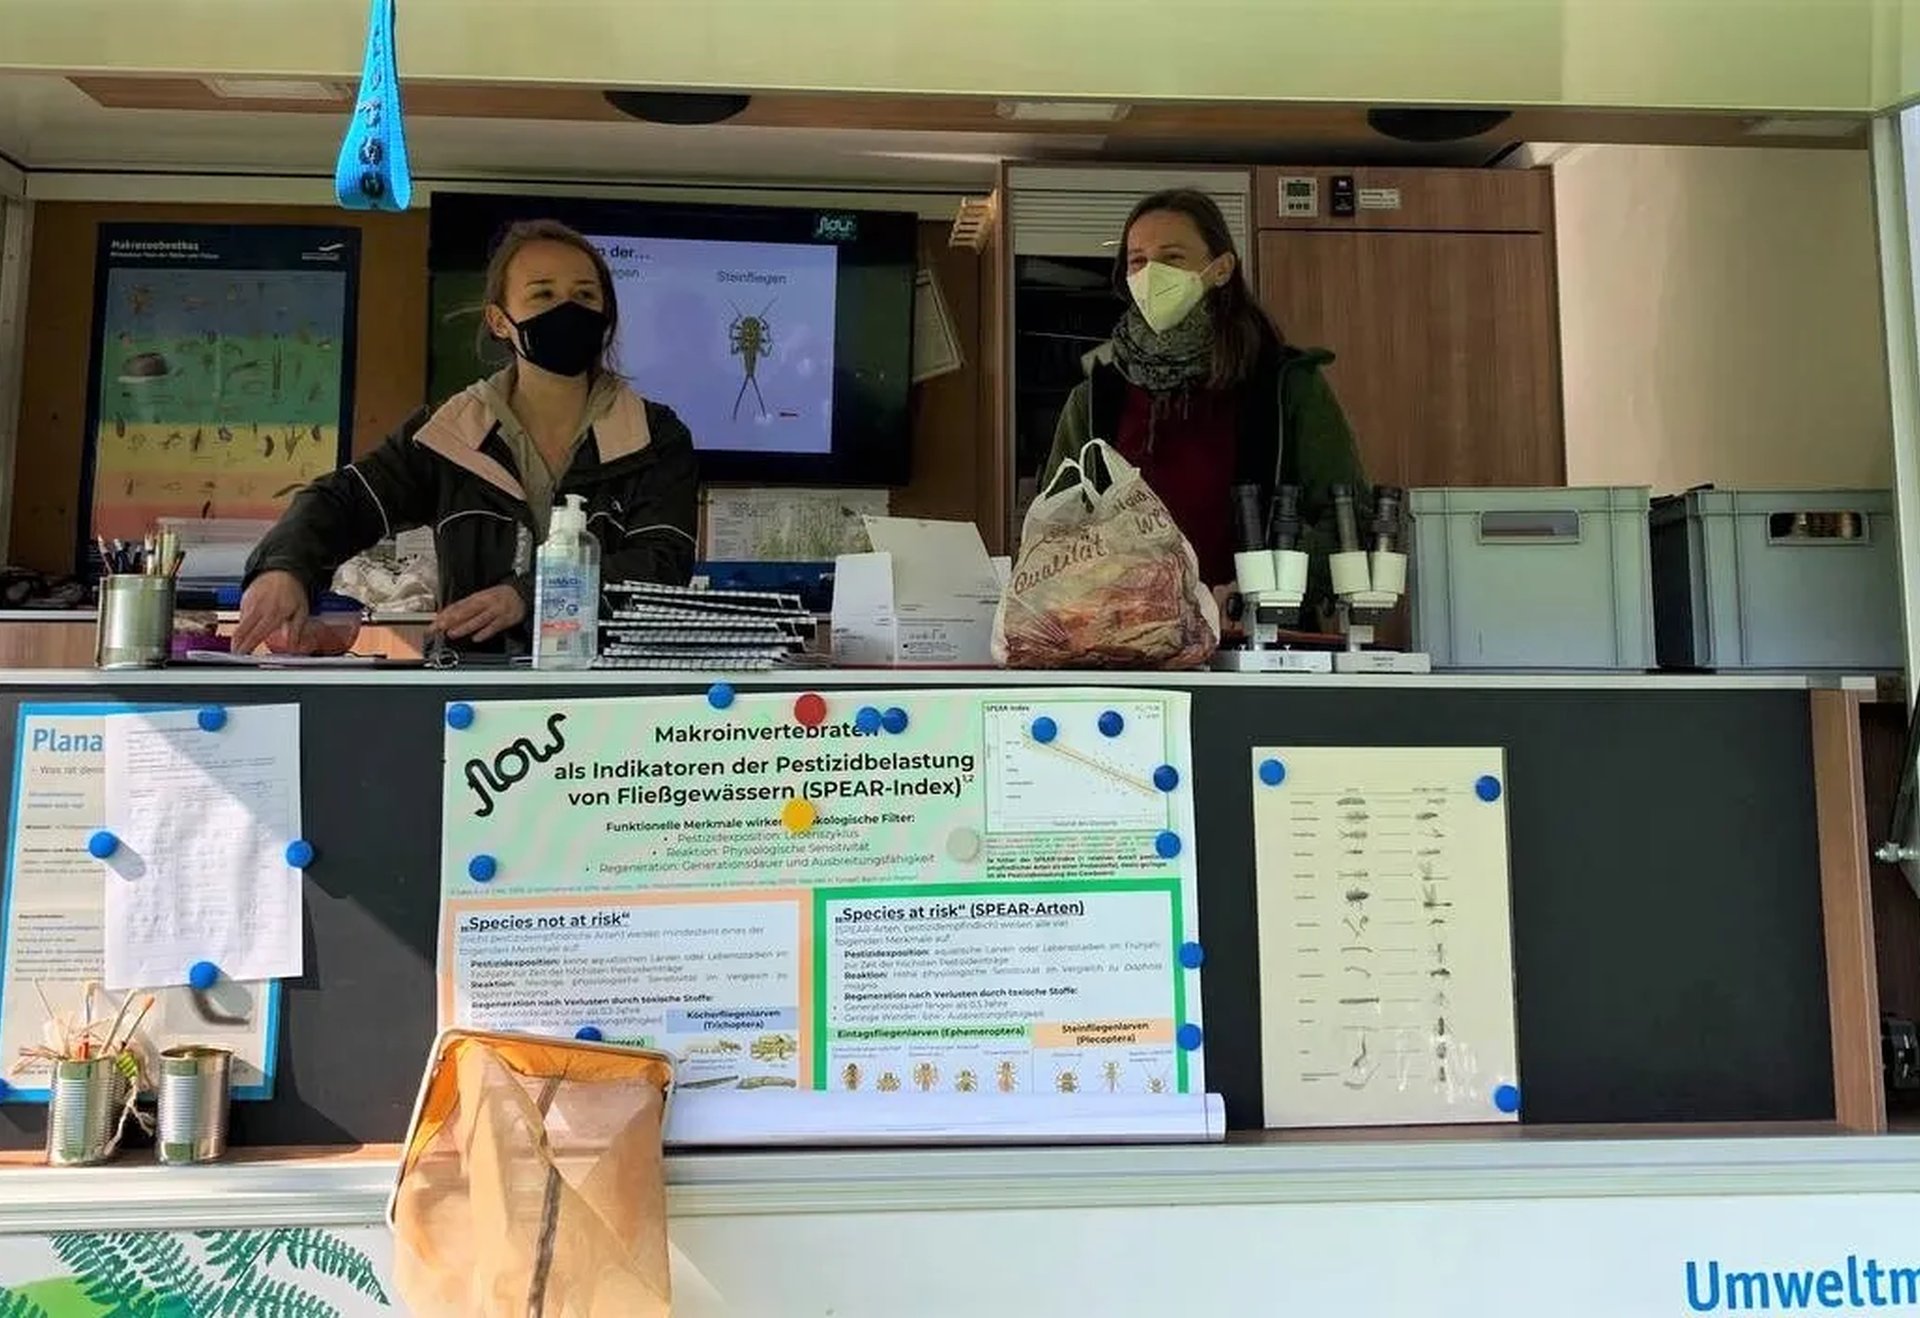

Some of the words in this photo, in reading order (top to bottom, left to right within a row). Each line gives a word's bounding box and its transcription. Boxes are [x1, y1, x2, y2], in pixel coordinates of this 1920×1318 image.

[33, 728, 104, 752] Plana
[555, 762, 586, 781] als
[593, 757, 726, 779] Indikatoren
[731, 755, 768, 776] der
[777, 752, 975, 775] Pestizidbelastung
[569, 789, 612, 806] von
[618, 783, 795, 808] Fließgewässern
[606, 822, 681, 833] Funktionelle
[684, 820, 743, 831] Merkmale
[812, 815, 879, 828] kologische
[882, 812, 916, 825] Filter:
[835, 906, 904, 924] „Species
[909, 907, 925, 920] at
[970, 900, 1085, 919] (SPEAR-Arten)
[461, 914, 532, 932] „Species
[538, 915, 565, 929] not
[571, 914, 586, 927] at
[909, 989, 931, 1000] nach
[934, 988, 977, 999] Verlusten
[980, 987, 1006, 998] durch
[687, 1008, 781, 1021] Köcherfliegenlarven
[703, 1019, 765, 1032] (Trichoptera)
[838, 1027, 939, 1039] Eintagsfliegenlarven
[941, 1024, 1025, 1039] (Ephemeroptera)
[1062, 1021, 1149, 1034] Steinfliegenlarven
[1685, 1254, 1920, 1312] Umweltm
